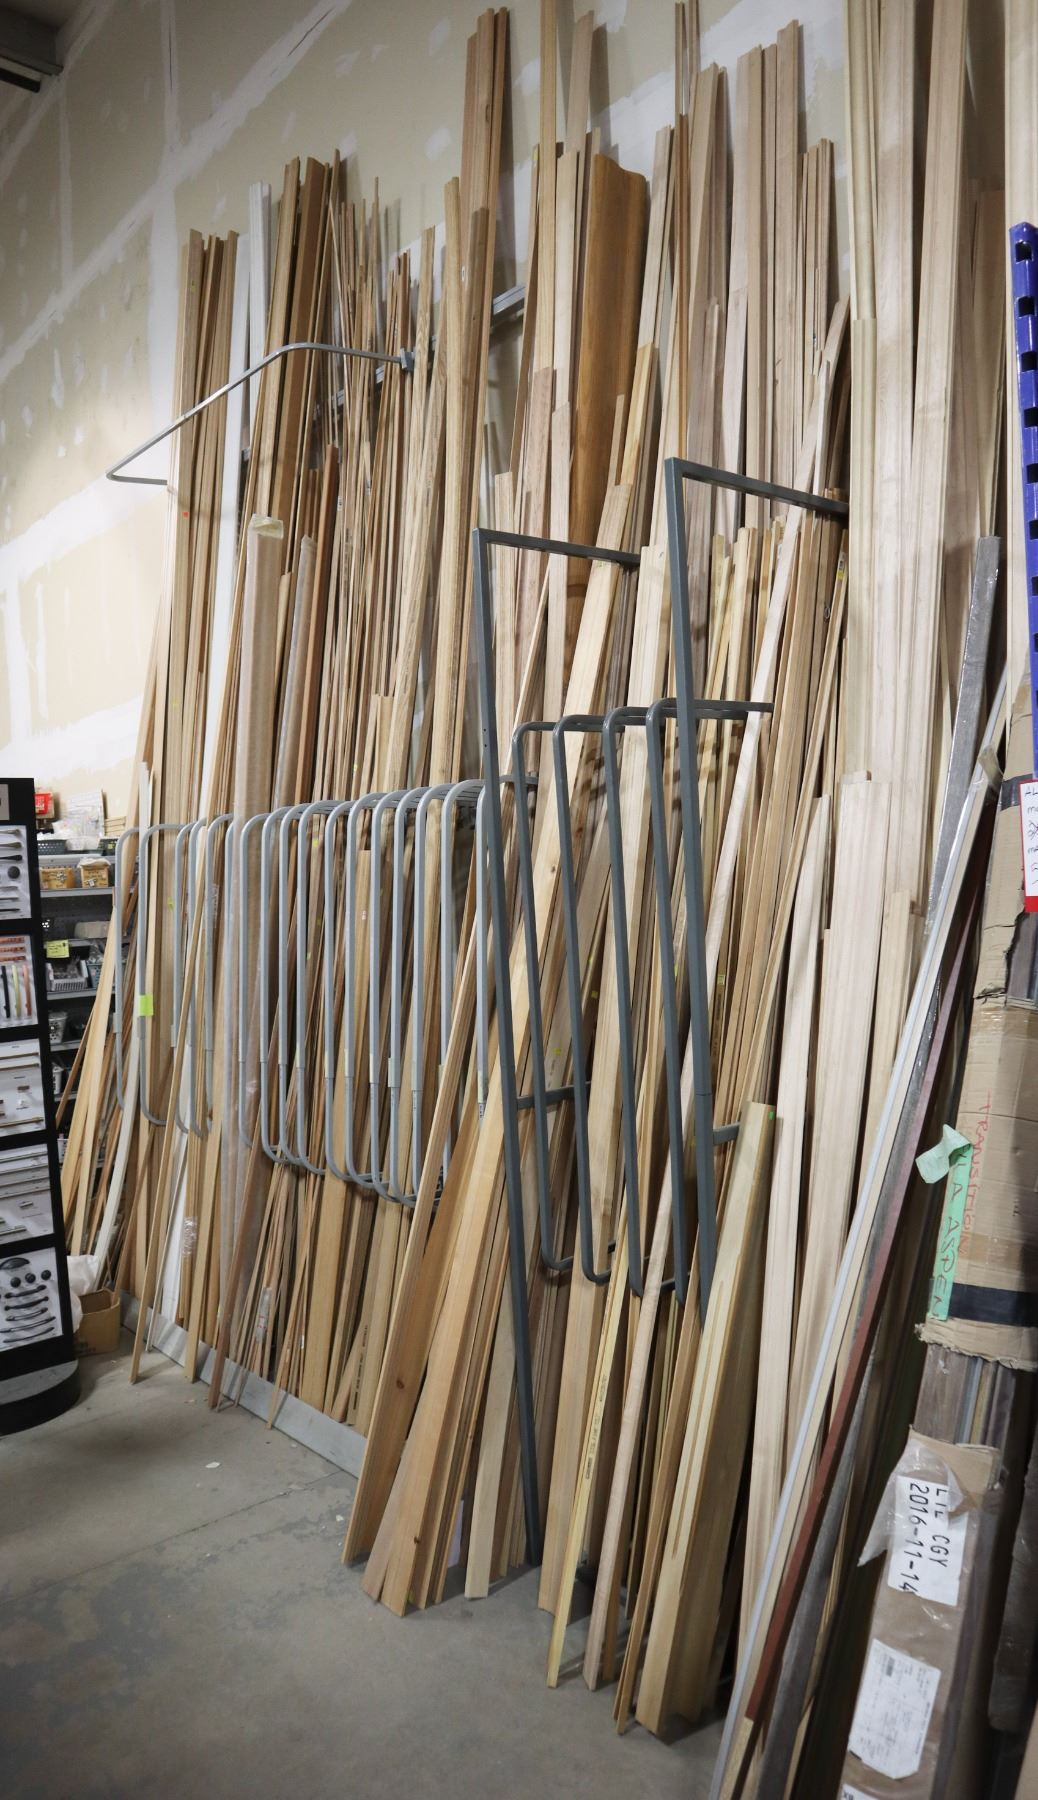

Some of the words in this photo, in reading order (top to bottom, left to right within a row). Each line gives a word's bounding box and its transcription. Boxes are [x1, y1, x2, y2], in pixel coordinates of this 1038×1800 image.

[958, 1088, 991, 1257] TRANSITION
[931, 1216, 960, 1317] ASPEN
[898, 1482, 930, 1594] 2016-11-14
[929, 1534, 951, 1568] CGY
